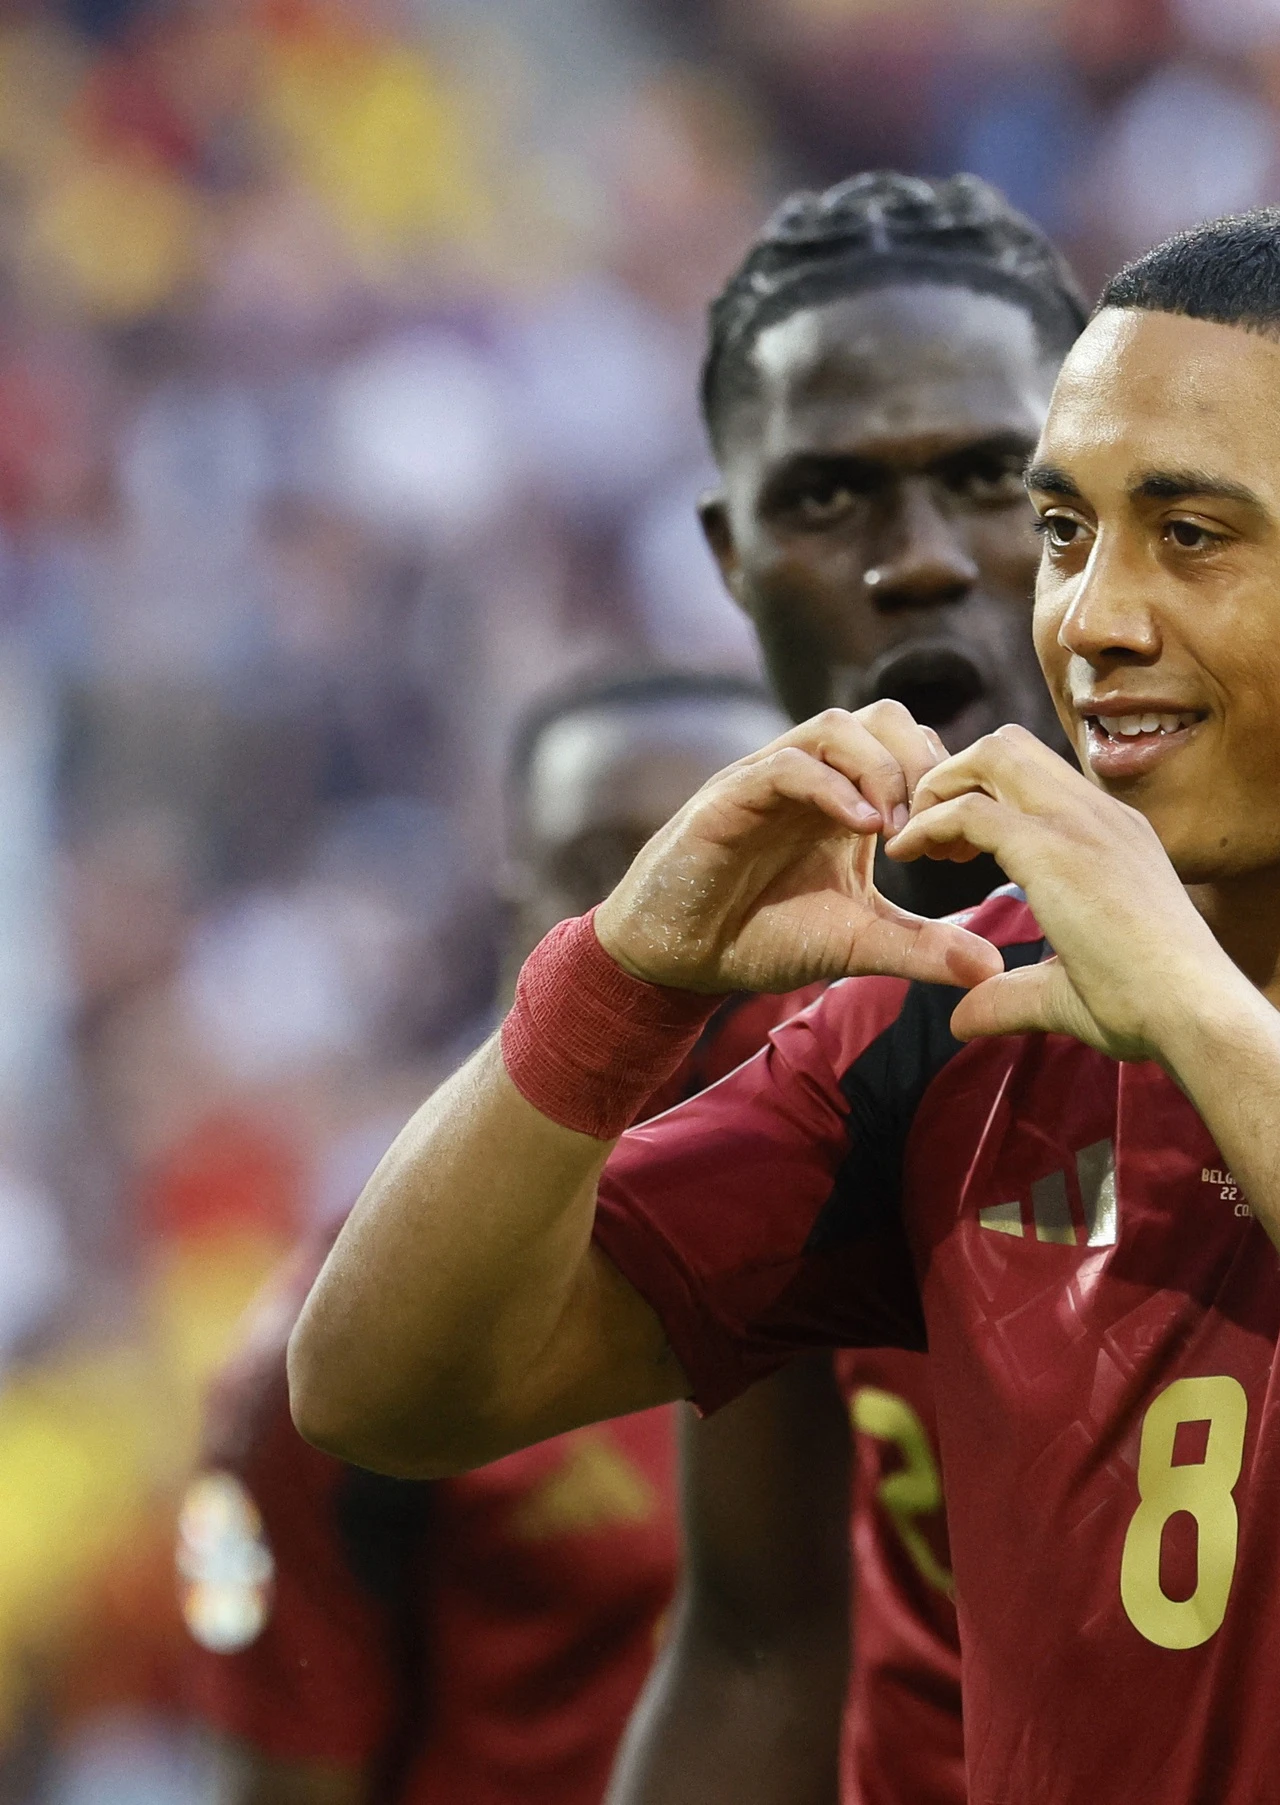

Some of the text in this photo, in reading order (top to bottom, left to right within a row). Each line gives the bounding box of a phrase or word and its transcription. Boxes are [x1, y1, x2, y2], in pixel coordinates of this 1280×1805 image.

[1201, 1168, 1236, 1184] BELG
[1220, 1187, 1237, 1200] 22
[1234, 1204, 1253, 1217] CO
[1120, 1375, 1248, 1650] 8
